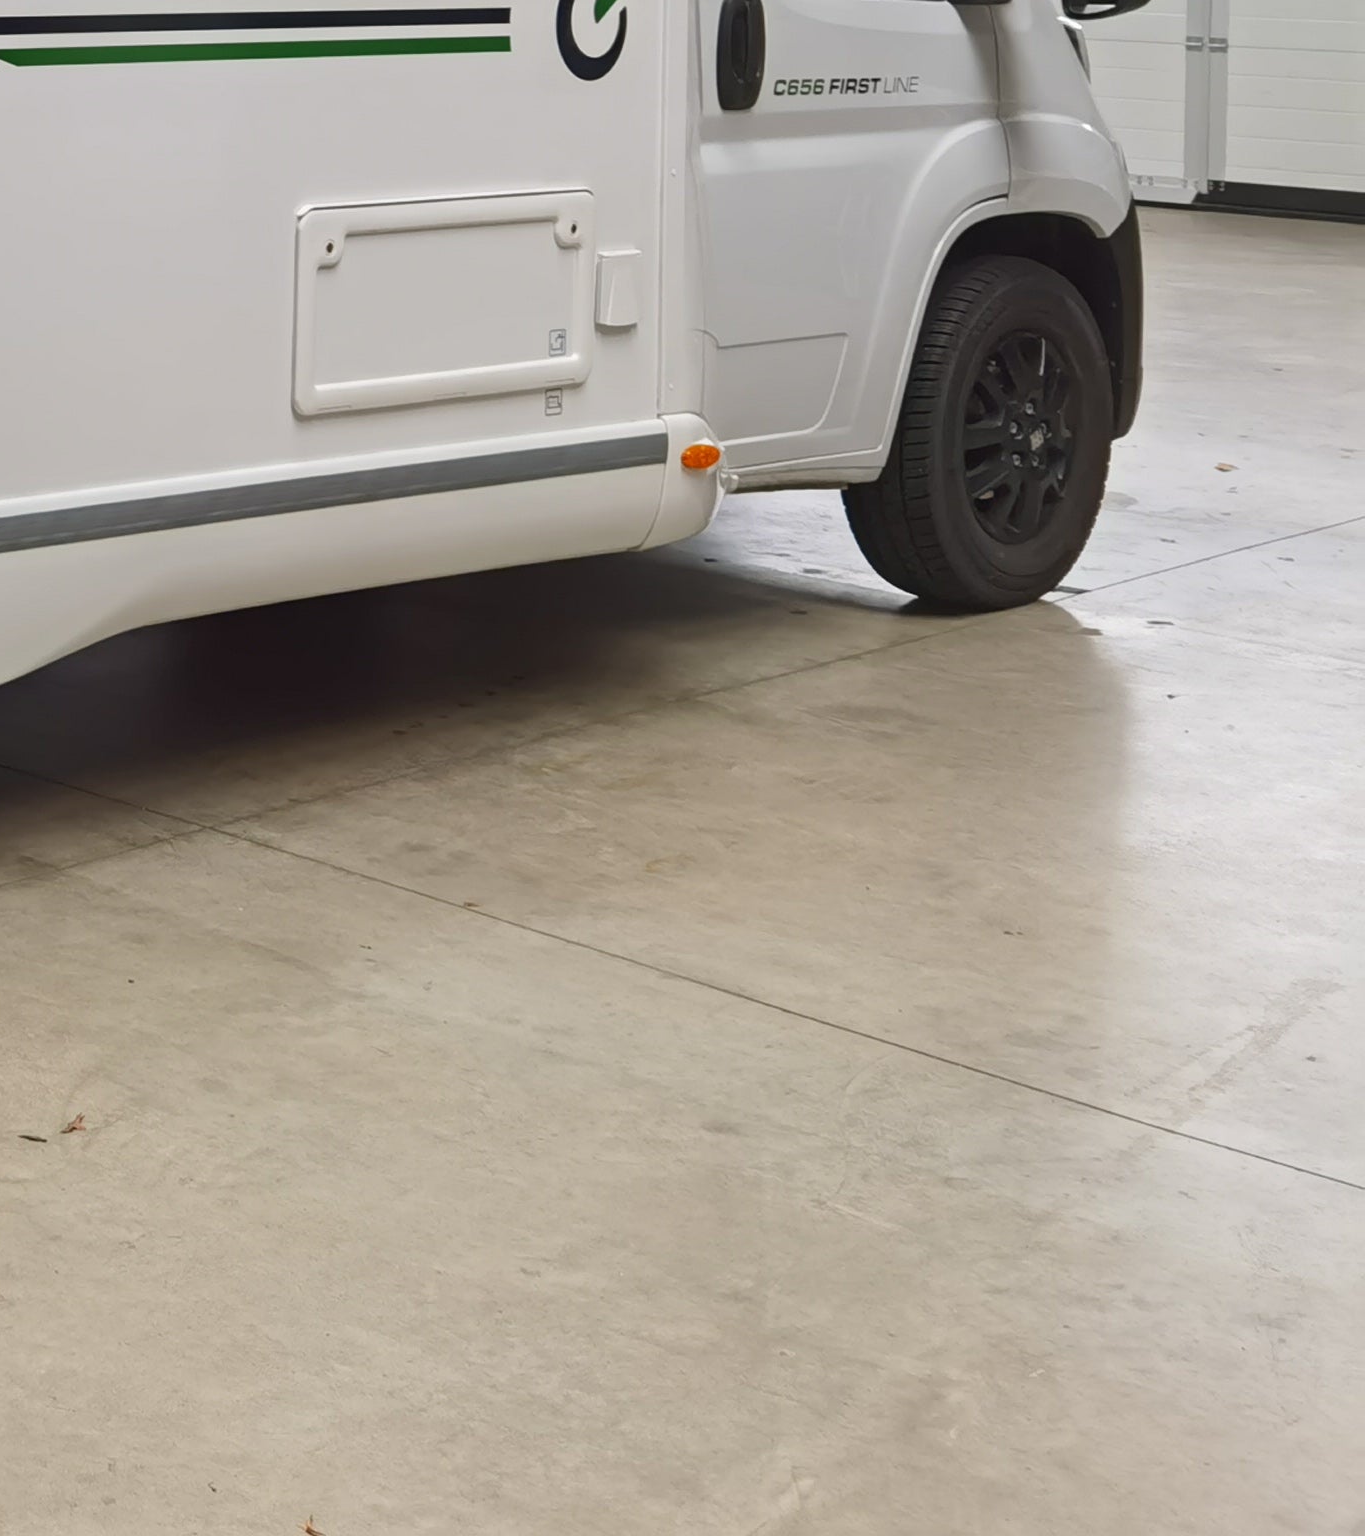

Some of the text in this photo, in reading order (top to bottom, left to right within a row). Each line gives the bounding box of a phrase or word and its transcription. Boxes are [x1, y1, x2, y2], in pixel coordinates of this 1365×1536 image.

[773, 76, 920, 97] C656 FIRST LINE
